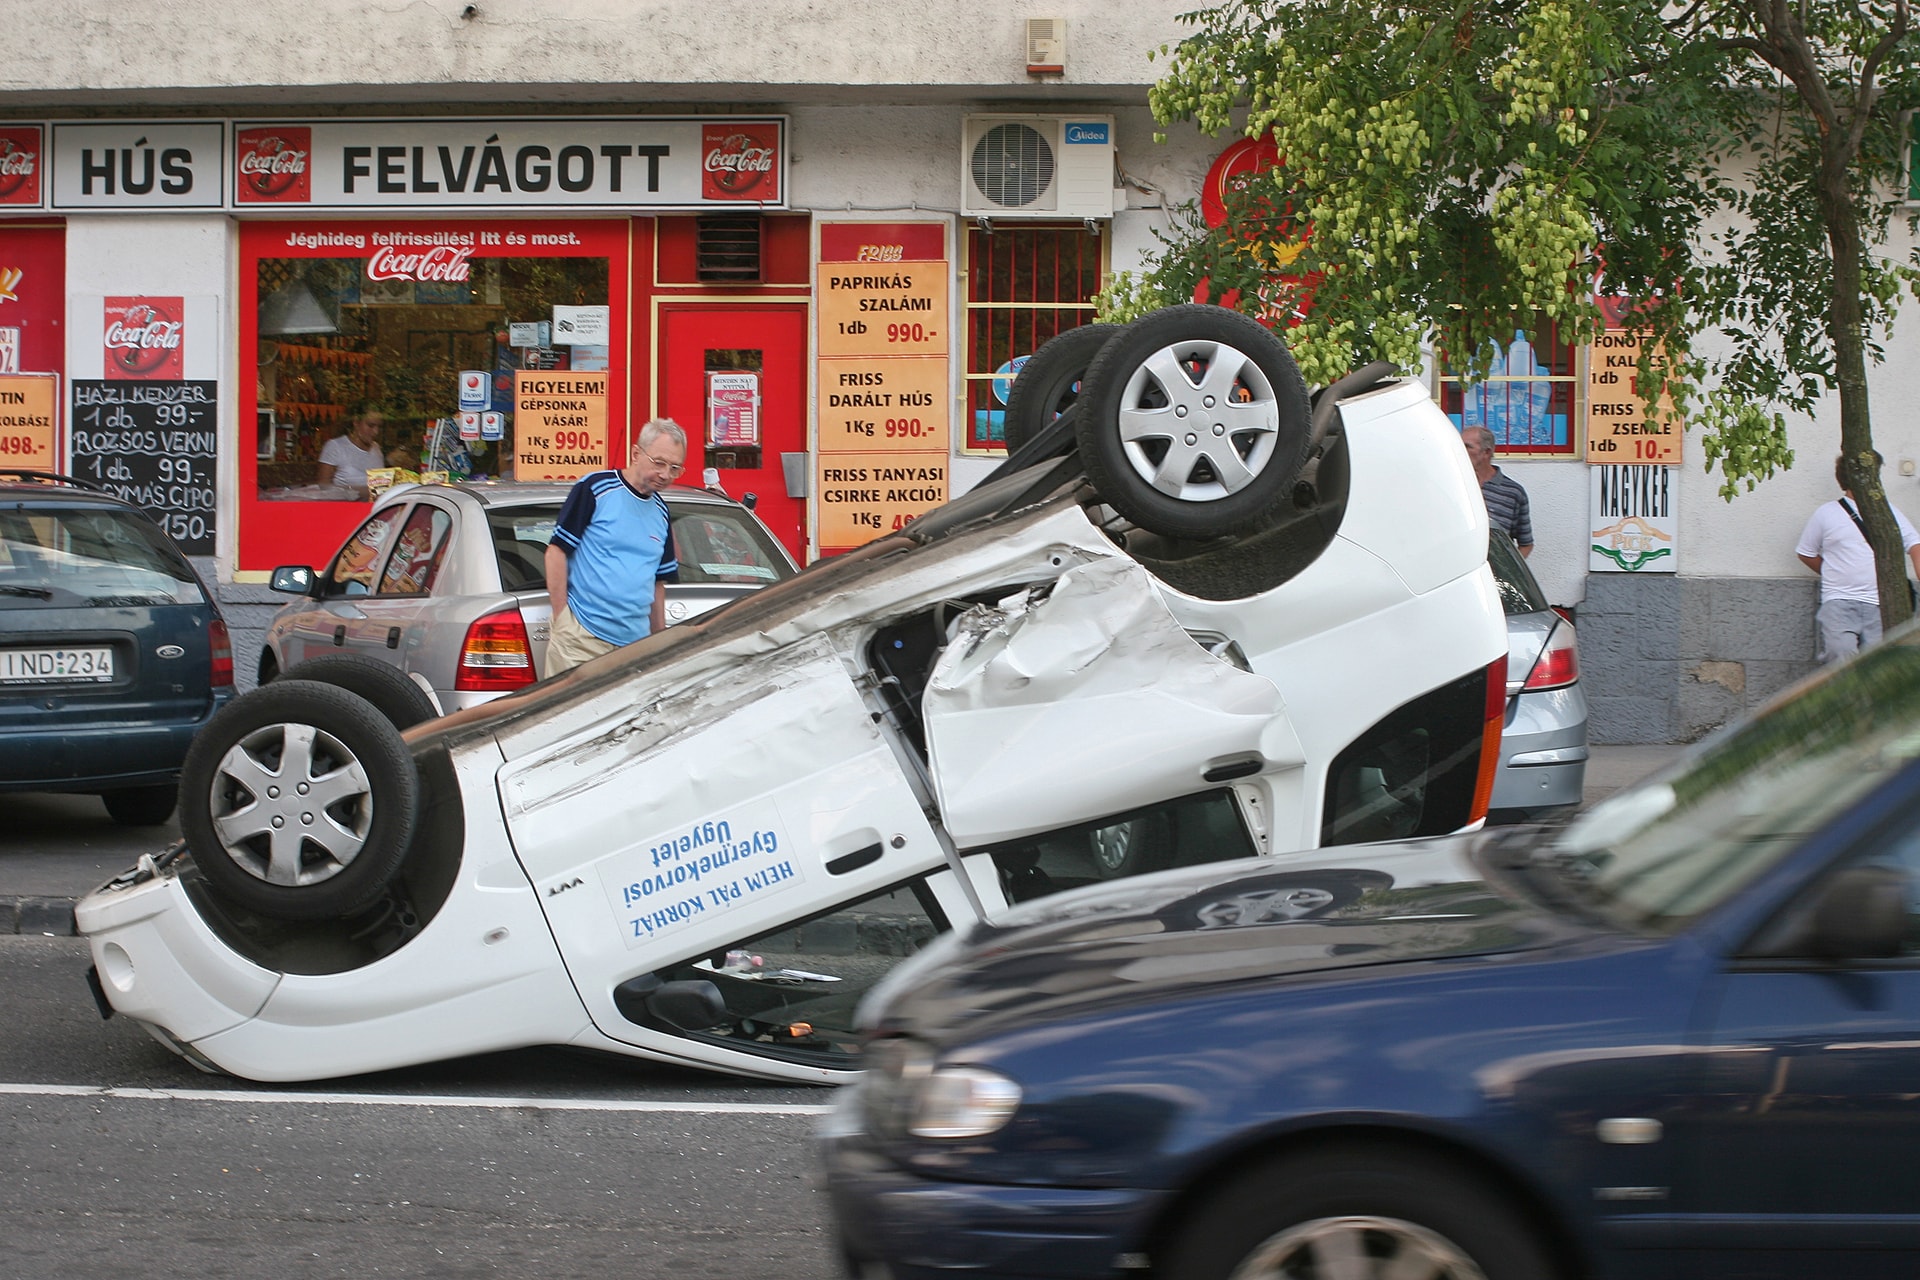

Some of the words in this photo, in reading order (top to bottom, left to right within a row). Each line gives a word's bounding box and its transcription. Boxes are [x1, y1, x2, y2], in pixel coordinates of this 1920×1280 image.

[1072, 129, 1105, 140] Midea
[82, 136, 194, 195] HÚS
[344, 134, 670, 194] FELVÁGOTT
[286, 231, 365, 249] Jéghideg
[371, 231, 475, 246] felfrissülés!
[480, 232, 501, 246] Itt
[505, 231, 527, 246] és
[531, 233, 581, 246] most.
[830, 273, 912, 290] PAPRIKÁS
[859, 295, 932, 312] SZALÁMI
[887, 323, 937, 343] 990.-
[1606, 355, 1665, 368] KALCS
[521, 381, 605, 394] FIGYELEM!
[839, 373, 883, 386] FRISS
[133, 382, 207, 401] KENYÉR
[830, 391, 892, 407] DARÁLT
[900, 390, 933, 406] HÚS
[520, 397, 587, 411] GÉPSONKA
[1592, 404, 1634, 416] FRISS
[83, 406, 100, 427] 1
[543, 414, 588, 427] VÁSÁR!
[885, 418, 936, 438] 990.-
[73, 431, 157, 451] ROZSOS
[161, 432, 215, 453] VEKNI
[555, 431, 603, 450] 990.-
[1634, 439, 1671, 459] 10.-
[88, 455, 102, 479] 1
[520, 452, 544, 464] TÉLI
[548, 453, 602, 466] SZALÁMI
[824, 469, 867, 482] FRISS
[873, 468, 943, 481] TANYASI
[824, 489, 880, 502] CSIRKE
[886, 486, 942, 502] AKCIÓ!
[1600, 465, 1669, 517] NAGYKER
[1611, 533, 1654, 551] PICK
[650, 820, 733, 868] Ügyelet
[622, 830, 778, 909] Gyermekorvosi
[742, 861, 795, 893] HEIM
[706, 881, 743, 909] PÁL
[629, 894, 706, 938] KÓRHÁZ
